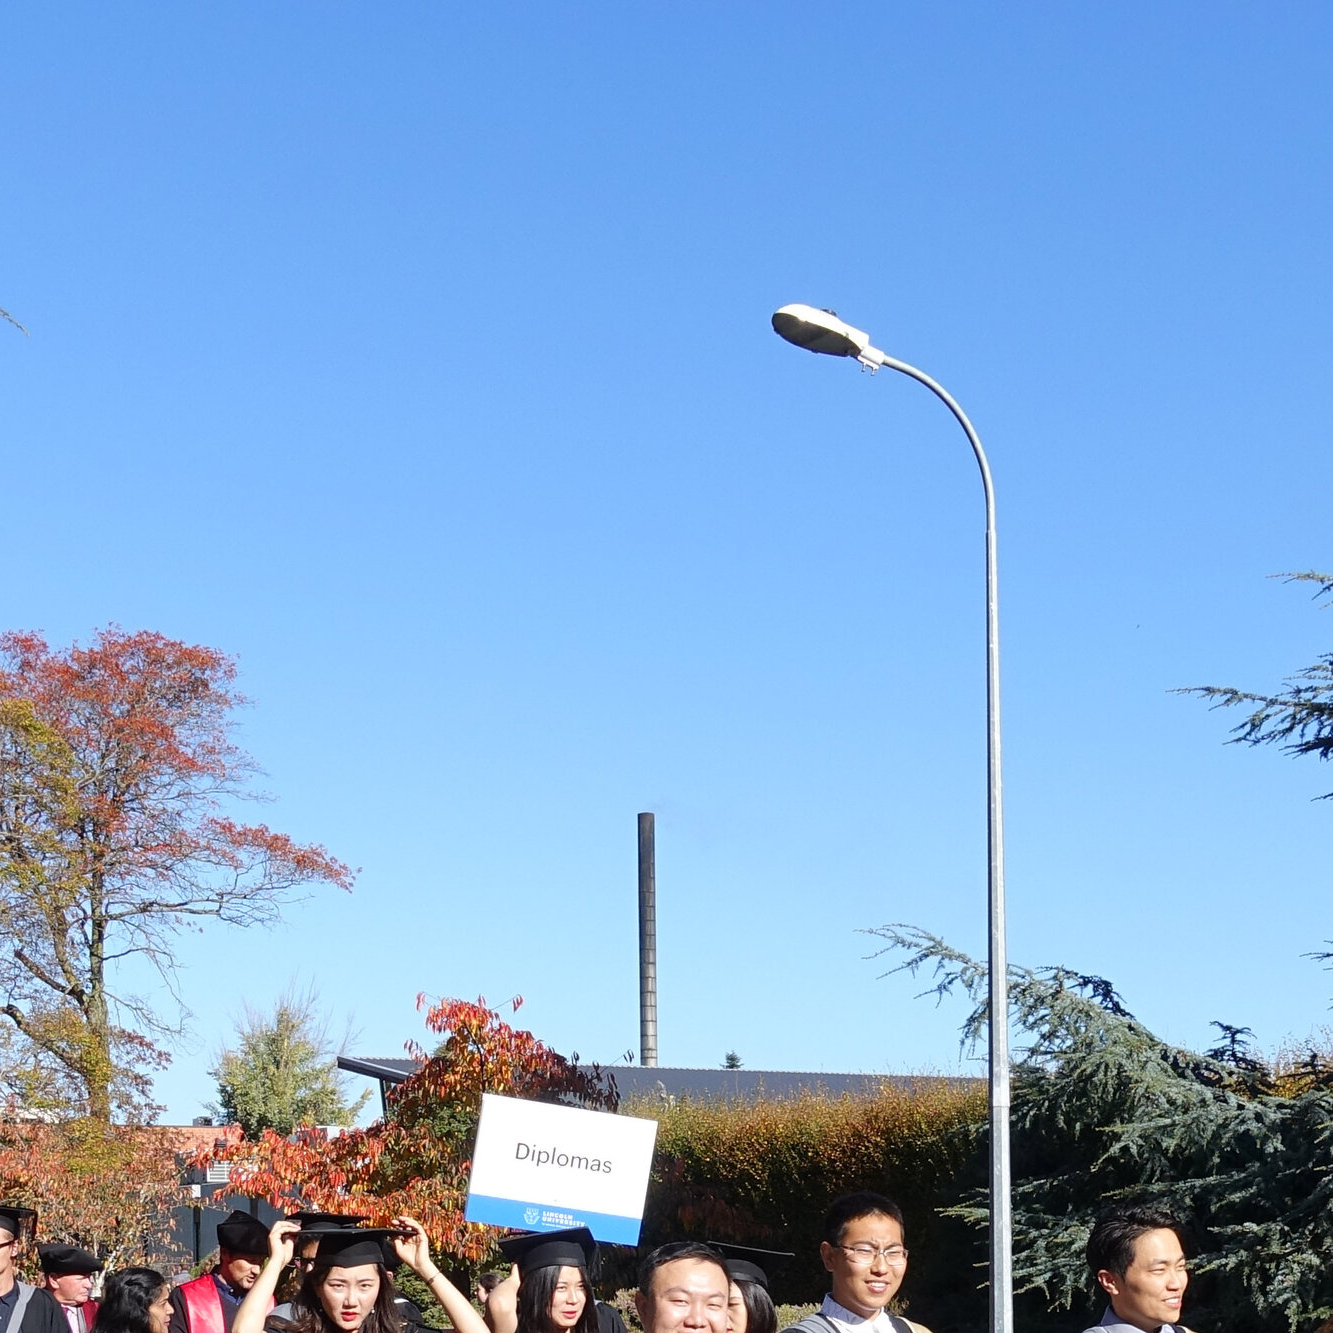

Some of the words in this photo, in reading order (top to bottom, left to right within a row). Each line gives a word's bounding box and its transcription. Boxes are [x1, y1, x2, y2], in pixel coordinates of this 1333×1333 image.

[515, 1142, 612, 1174] Diplomas
[542, 1210, 574, 1220] LINCOLN
[542, 1216, 585, 1227] UNIVERSITY
